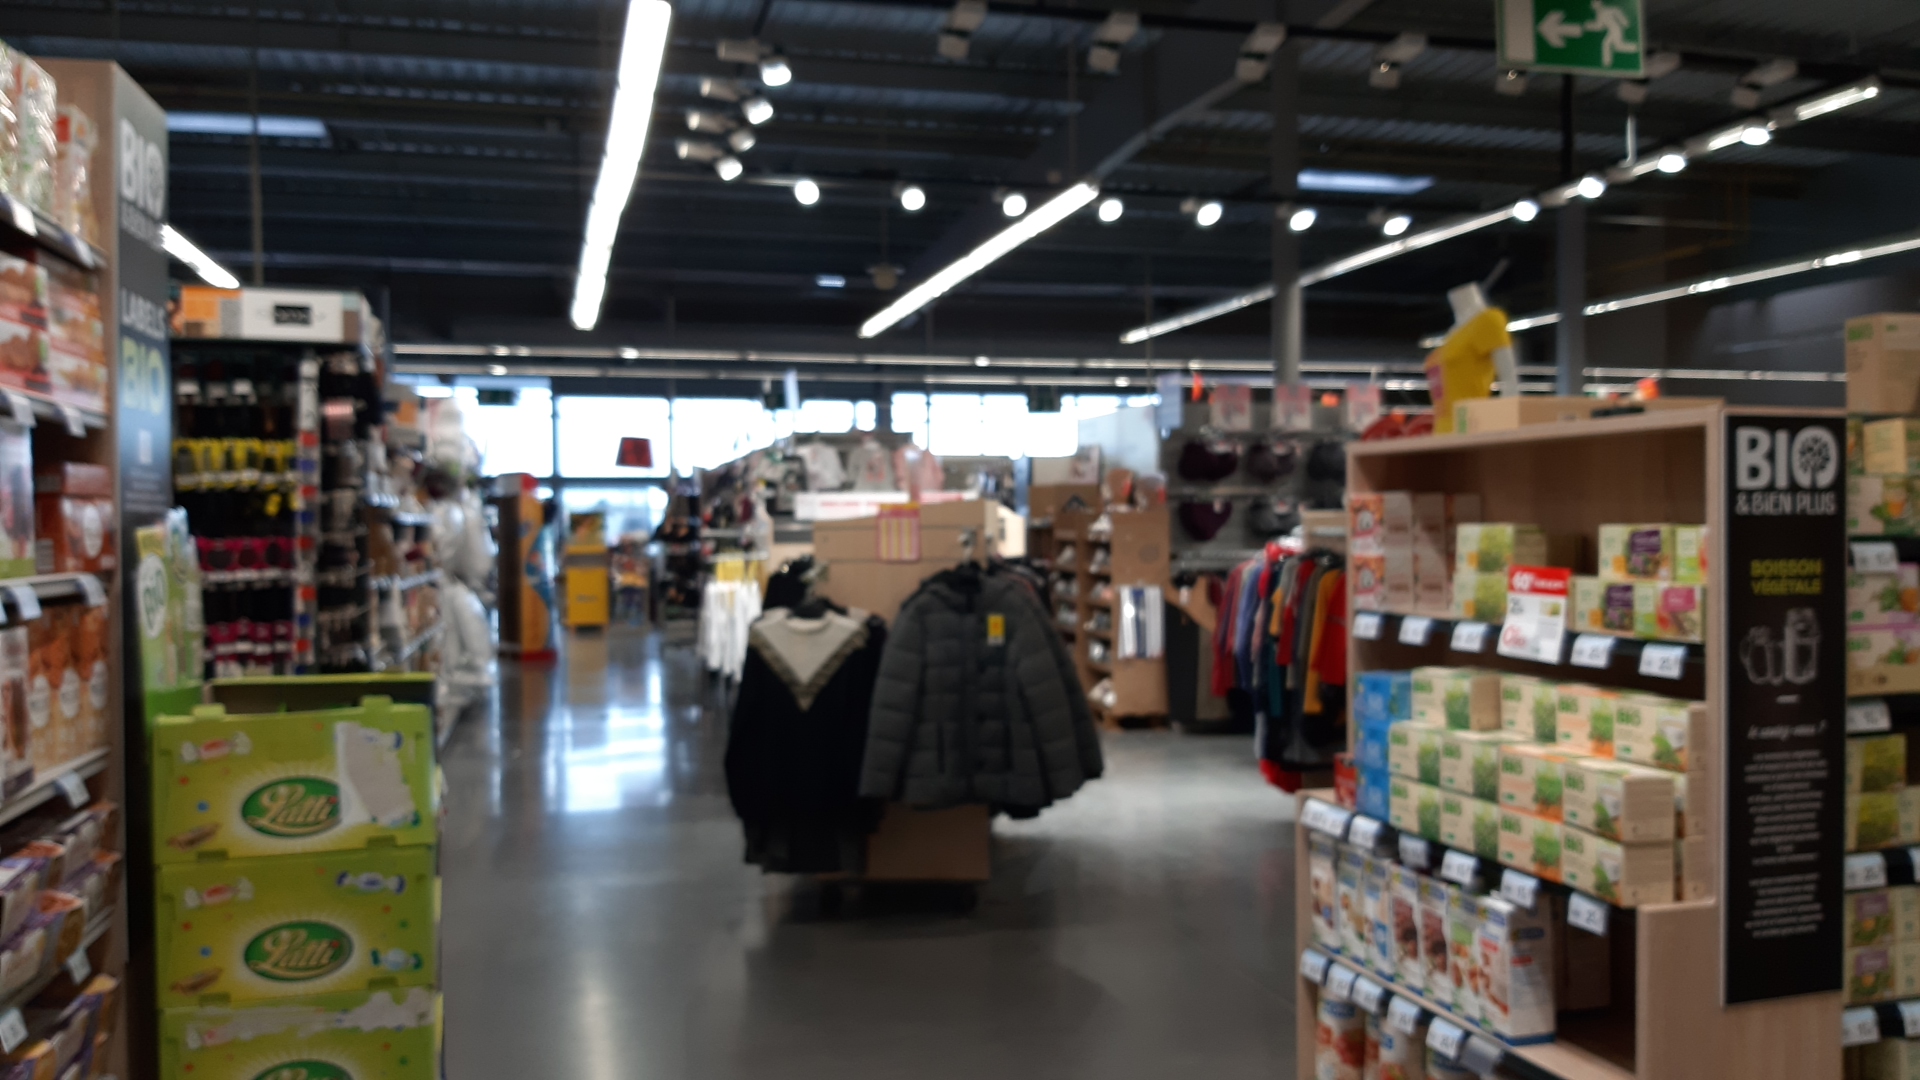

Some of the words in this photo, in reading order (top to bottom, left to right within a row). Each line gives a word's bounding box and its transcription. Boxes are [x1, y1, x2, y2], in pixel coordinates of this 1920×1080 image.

[120, 118, 164, 220] BIO
[122, 335, 165, 416] BIO
[1735, 425, 1839, 491] BIO
[1736, 491, 1749, 515] &
[1797, 491, 1836, 515] PLUS
[1750, 559, 1822, 577] BOISSON
